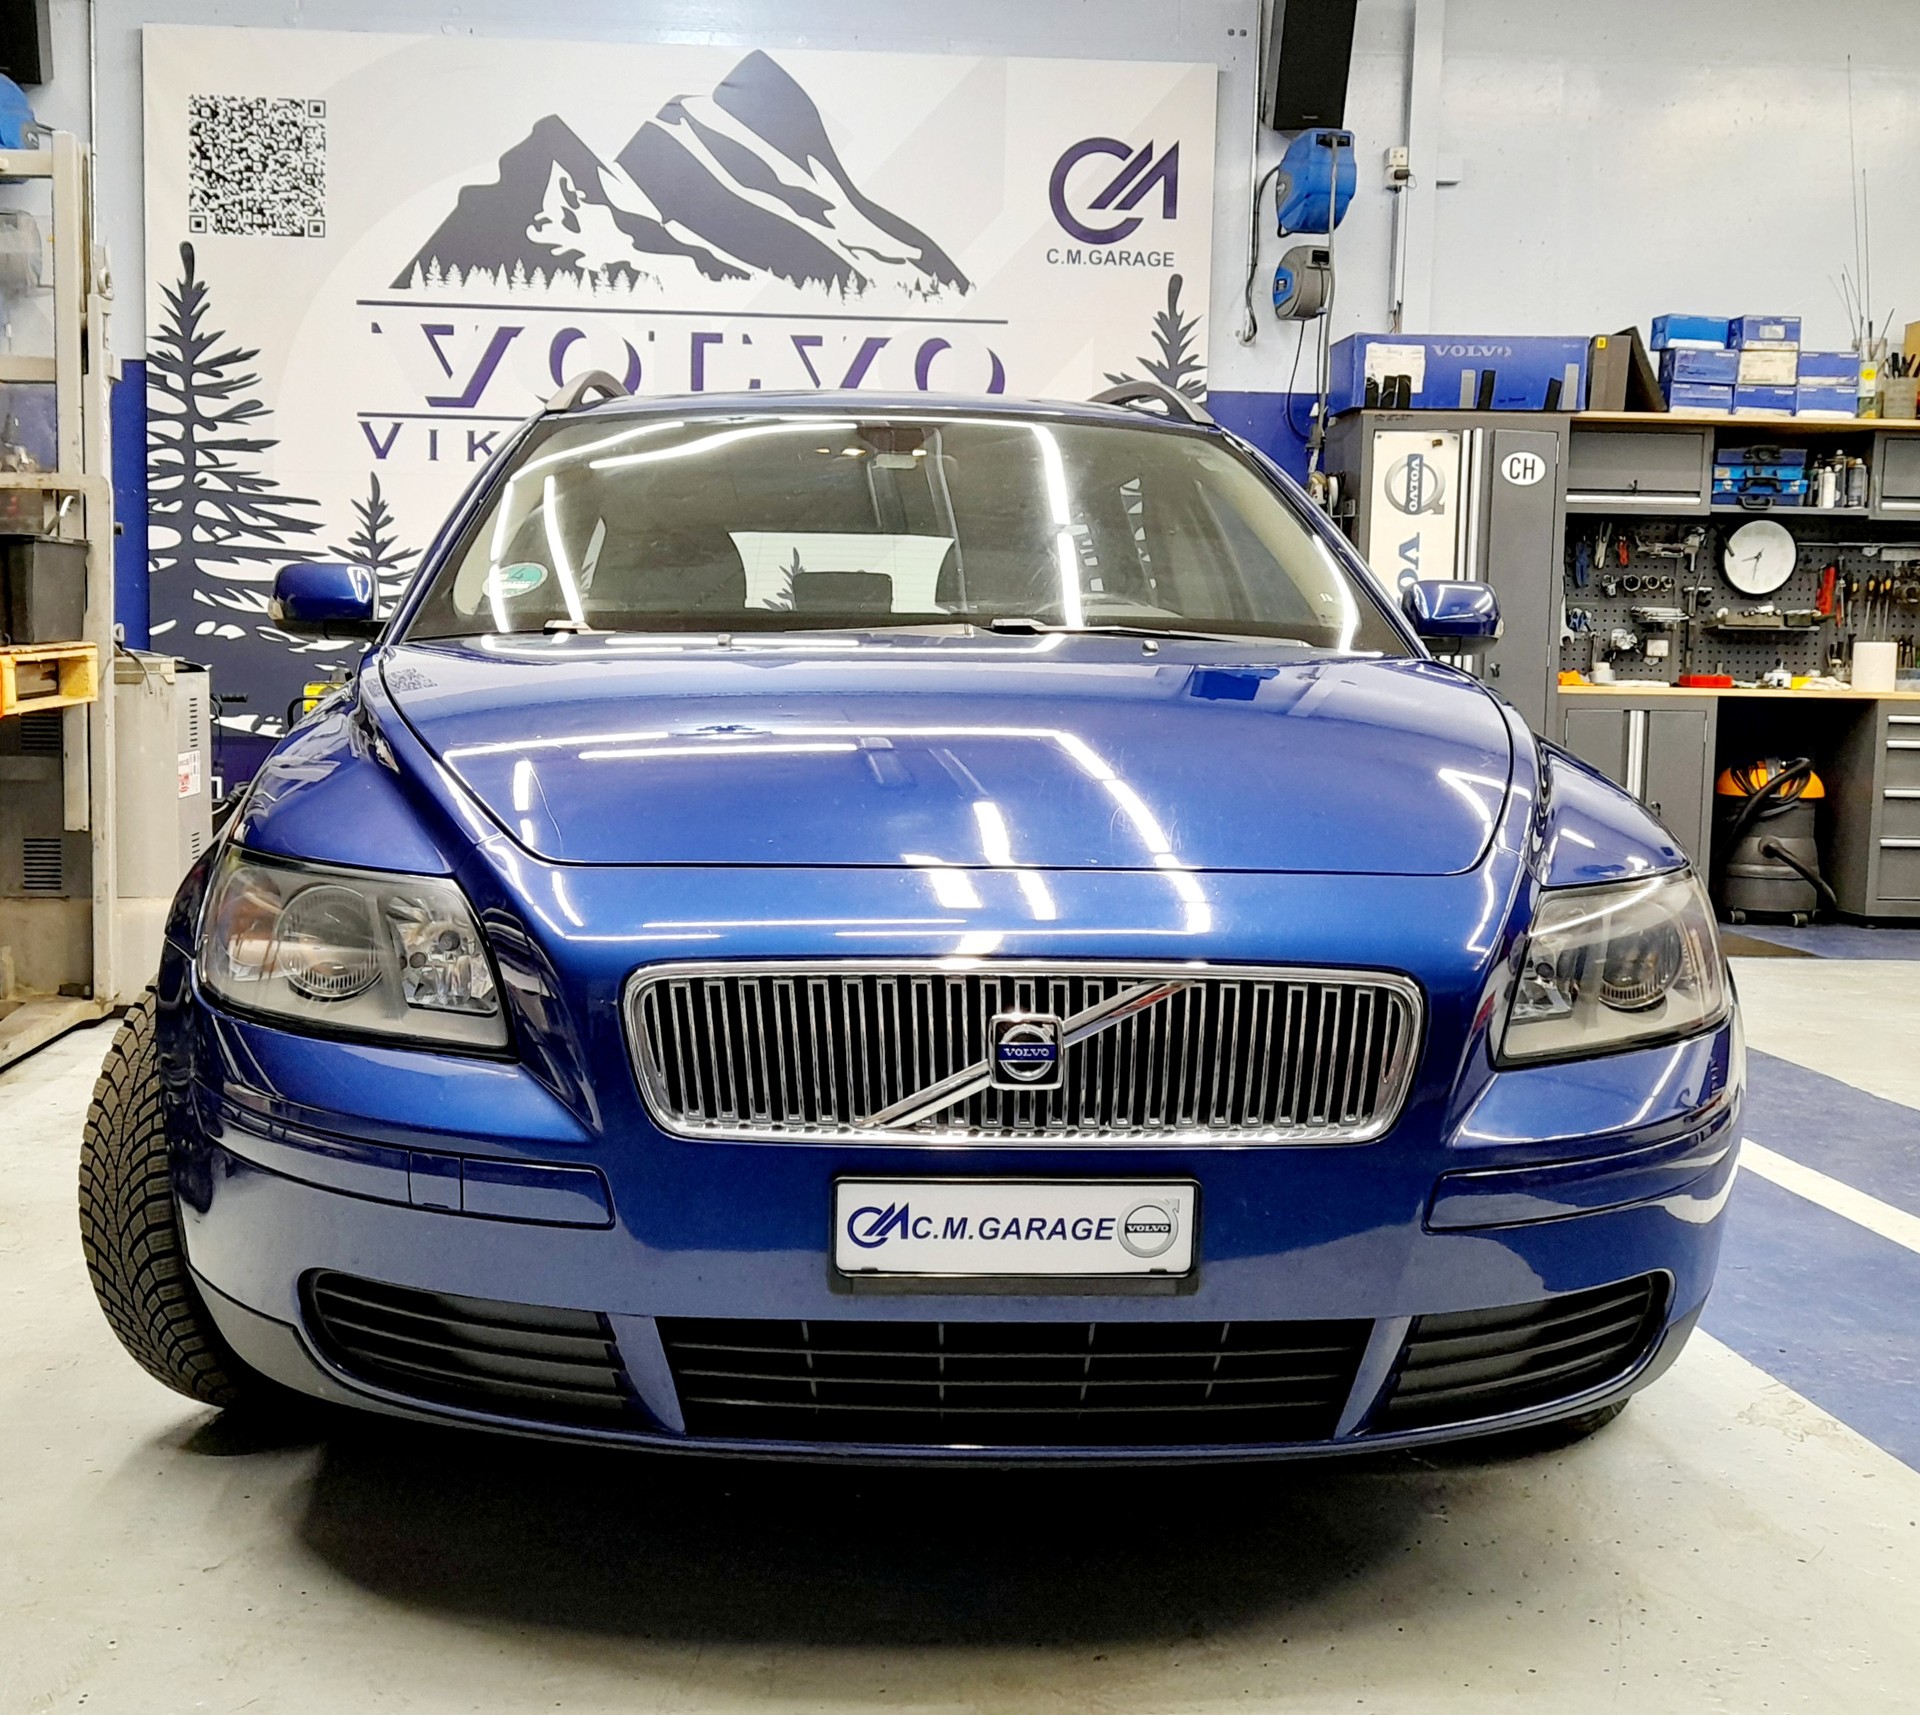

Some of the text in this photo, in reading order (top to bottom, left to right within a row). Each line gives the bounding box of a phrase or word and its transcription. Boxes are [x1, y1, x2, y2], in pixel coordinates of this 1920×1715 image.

[1046, 248, 1175, 268] C.M.GARAGE
[1431, 344, 1512, 358] VOLVO
[1509, 457, 1536, 480] CH
[1408, 457, 1421, 512] VOLVO
[1003, 1047, 1050, 1057] VOLVO
[912, 1217, 1116, 1241] C.M.GARAGE
[1127, 1224, 1169, 1233] VOLVO
